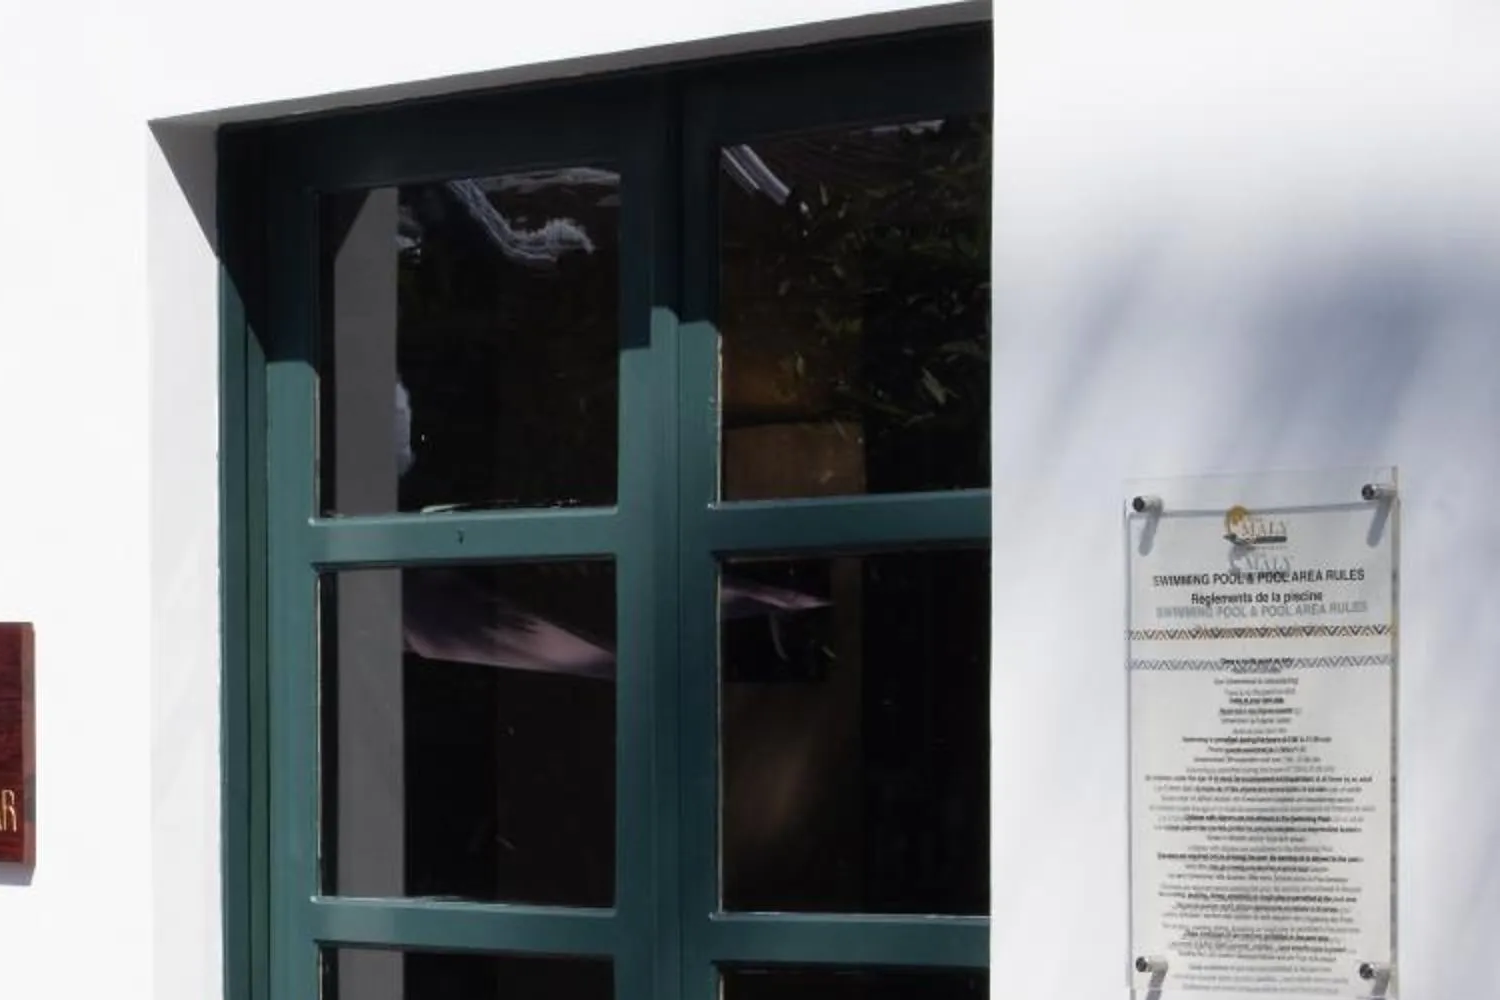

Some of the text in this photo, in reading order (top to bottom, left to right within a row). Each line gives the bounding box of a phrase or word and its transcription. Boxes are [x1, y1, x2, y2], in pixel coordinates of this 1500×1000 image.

[1153, 573, 1210, 587] SWIMMING
[1213, 572, 1245, 585] POOL
[1257, 570, 1290, 584] POOL
[1291, 569, 1322, 582] AREA
[1325, 567, 1365, 581] RULES
[1255, 591, 1268, 602] de
[1271, 591, 1281, 602] la
